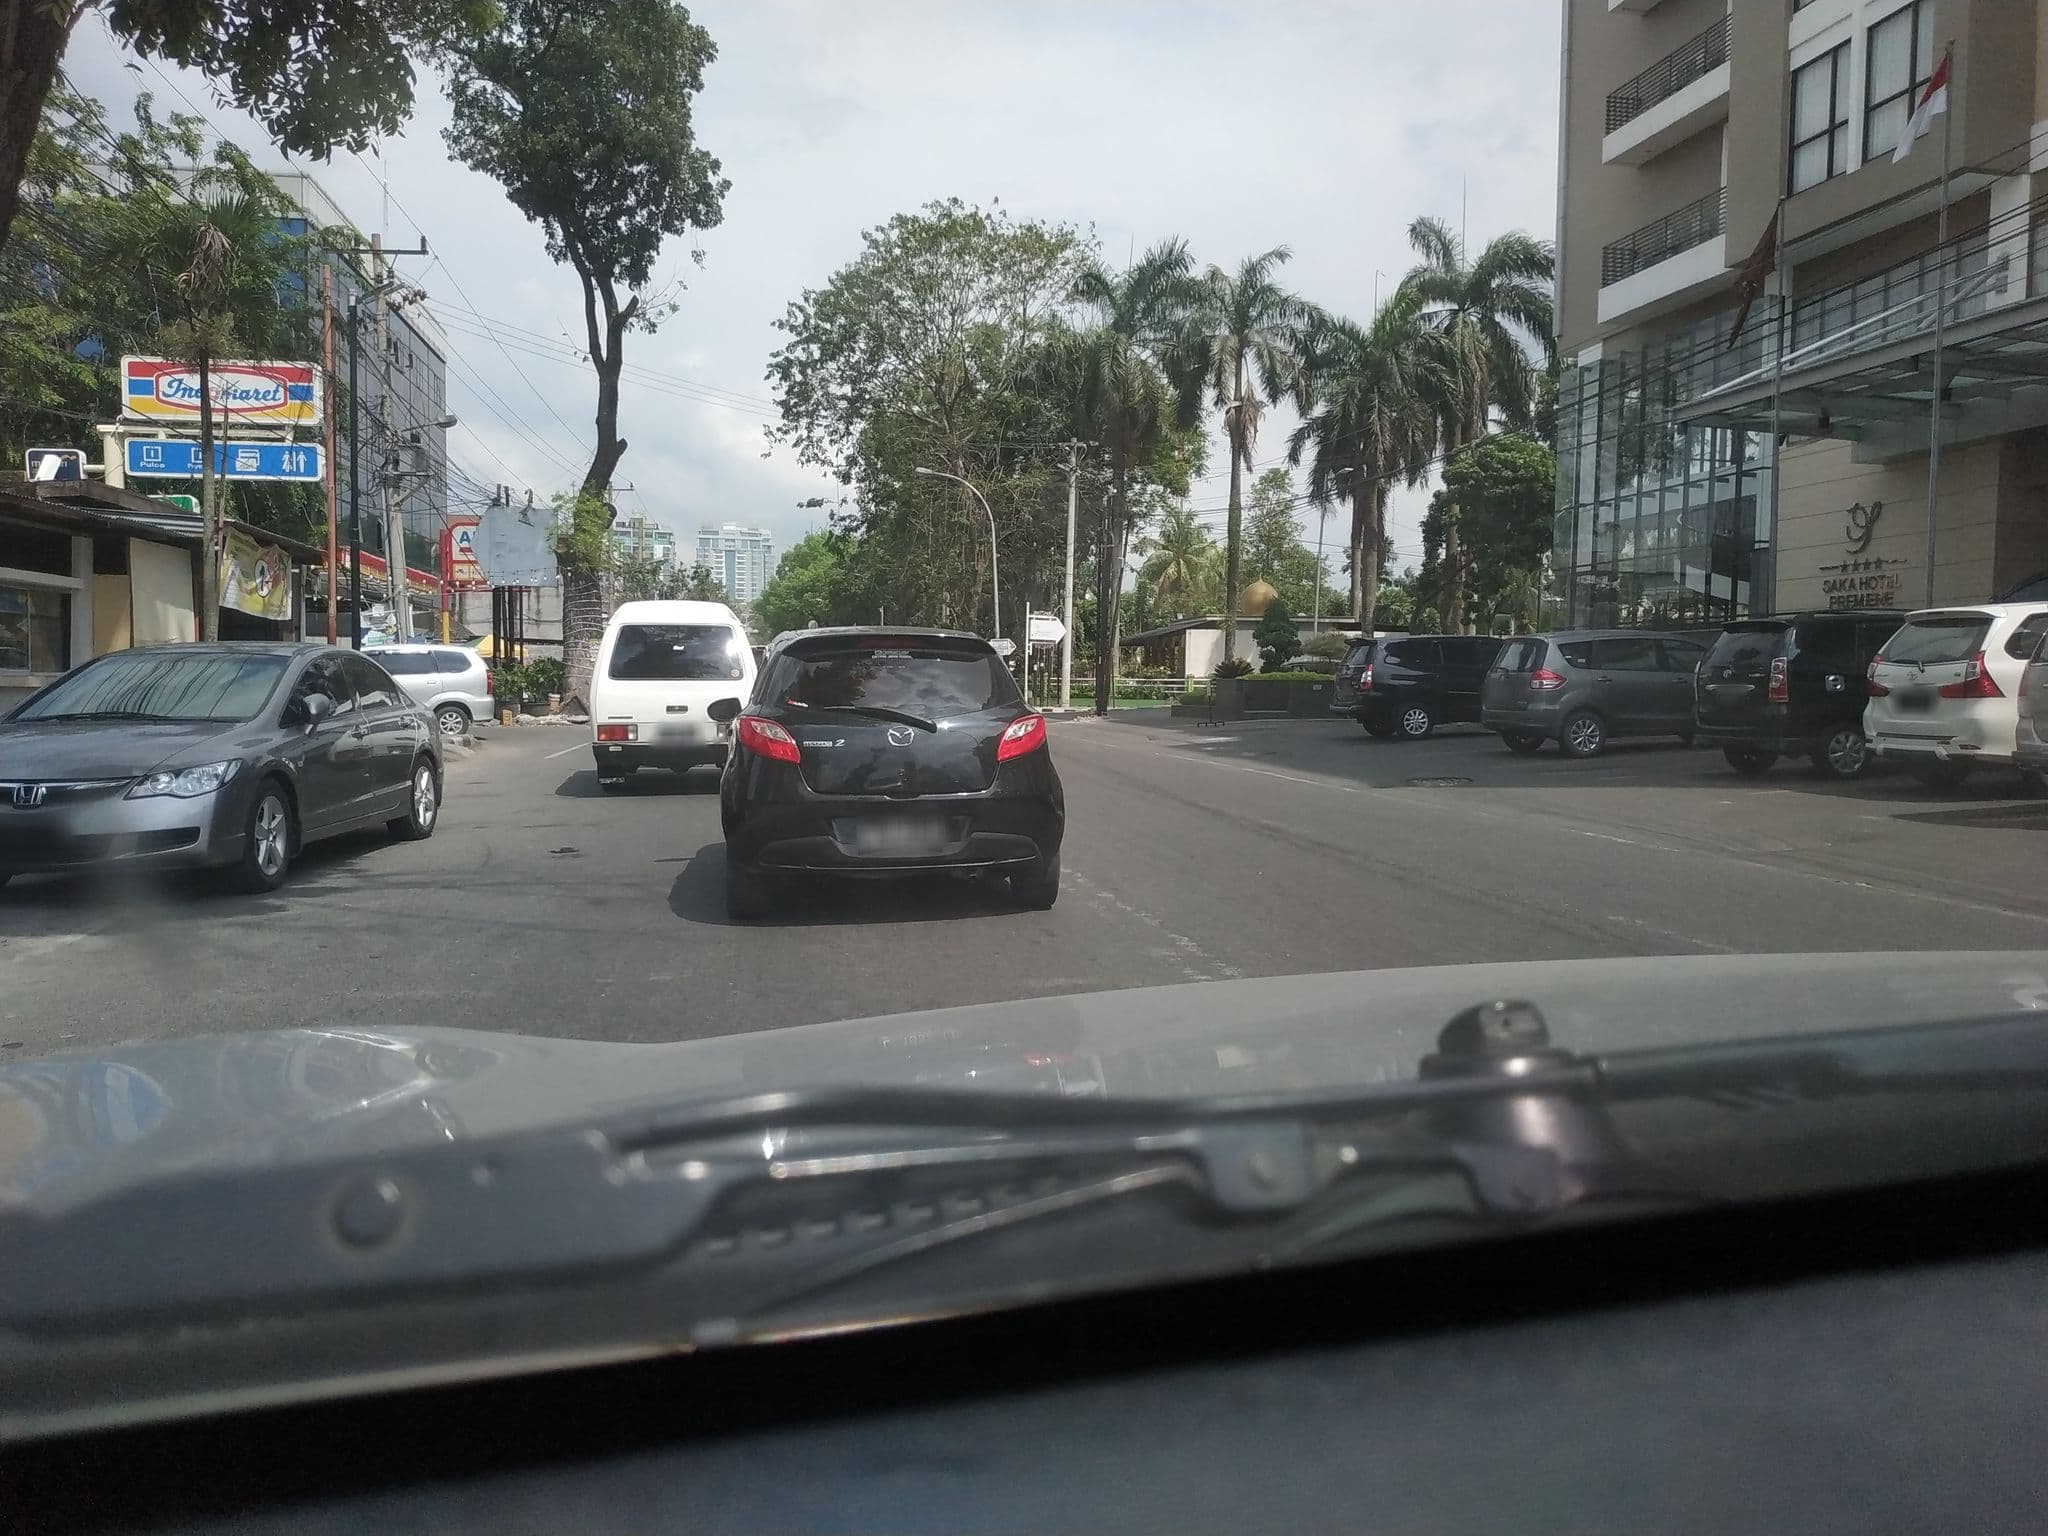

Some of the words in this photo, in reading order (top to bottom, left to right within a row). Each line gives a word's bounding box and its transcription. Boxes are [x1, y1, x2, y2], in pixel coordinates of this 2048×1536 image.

[1822, 577, 1857, 594] SAKA
[1858, 573, 1903, 591] HOTEL
[834, 738, 846, 747] 2
